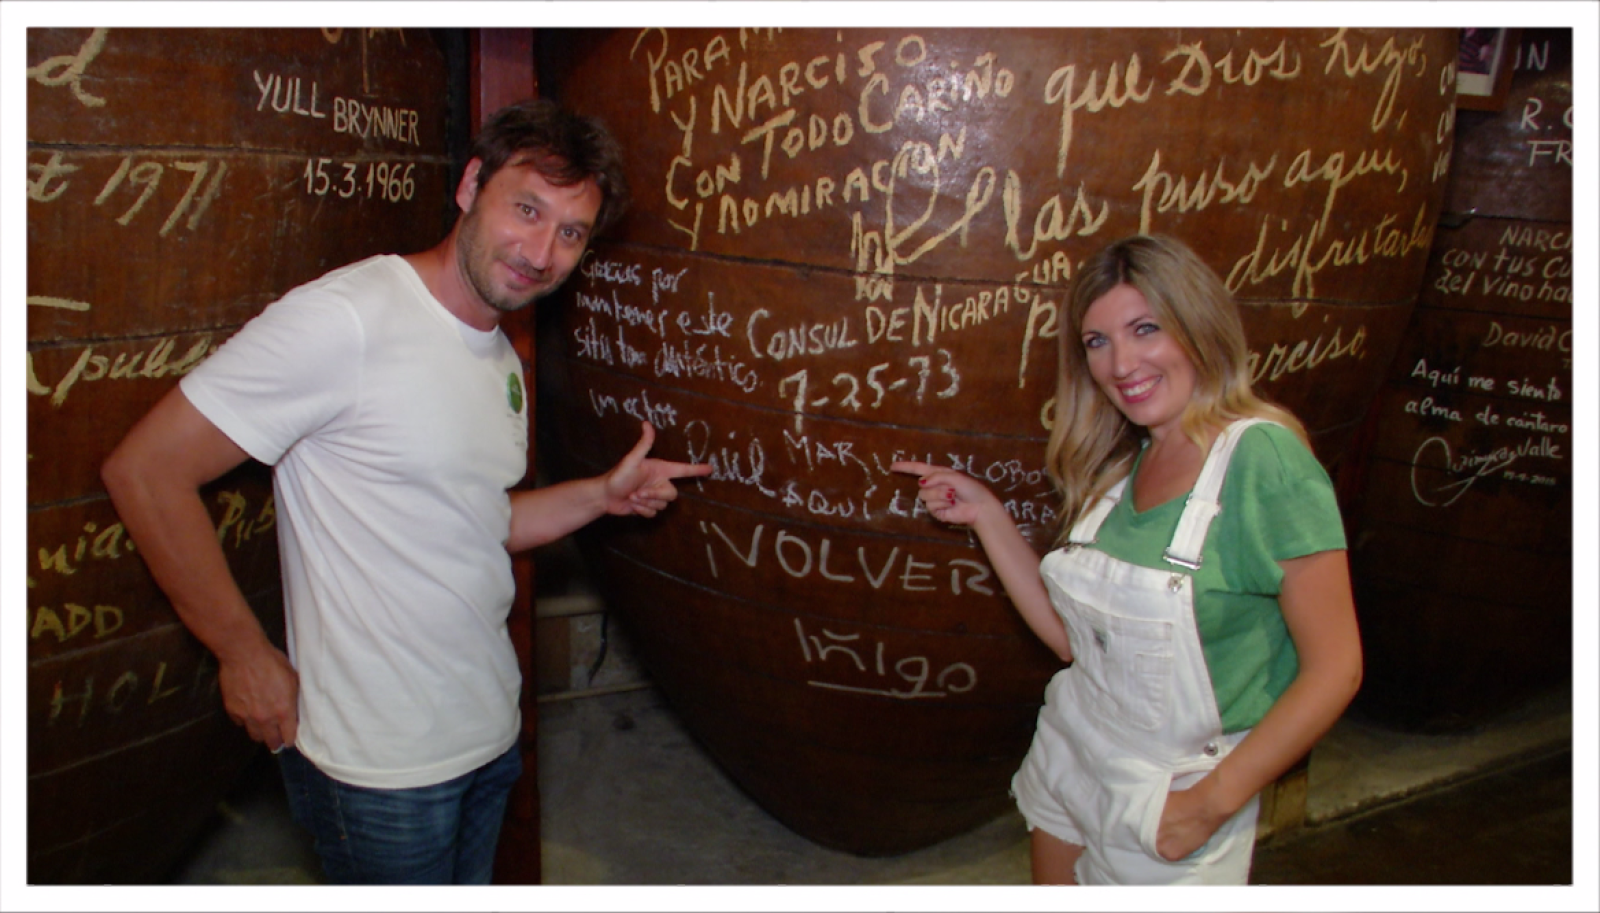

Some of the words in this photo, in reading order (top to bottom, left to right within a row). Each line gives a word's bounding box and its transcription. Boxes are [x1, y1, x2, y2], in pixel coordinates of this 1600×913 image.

[629, 27, 732, 113] PARA
[670, 95, 696, 158] Y
[711, 34, 927, 134] NARCISO
[252, 69, 326, 118] YULL
[332, 98, 420, 147] BRYNNER
[1044, 54, 1154, 179] que
[1161, 38, 1301, 96] Dios
[302, 158, 416, 202] 15.3.1966
[665, 152, 741, 209] CON
[741, 108, 854, 180] TODO
[93, 153, 228, 238] 1971
[667, 202, 703, 252] Y
[745, 307, 857, 360] CONSUL
[864, 306, 905, 346] DE
[1482, 321, 1557, 350] David
[1411, 358, 1461, 388] Aquí
[1468, 376, 1495, 391] me
[1404, 397, 1463, 421] alma
[1475, 405, 1500, 426] de
